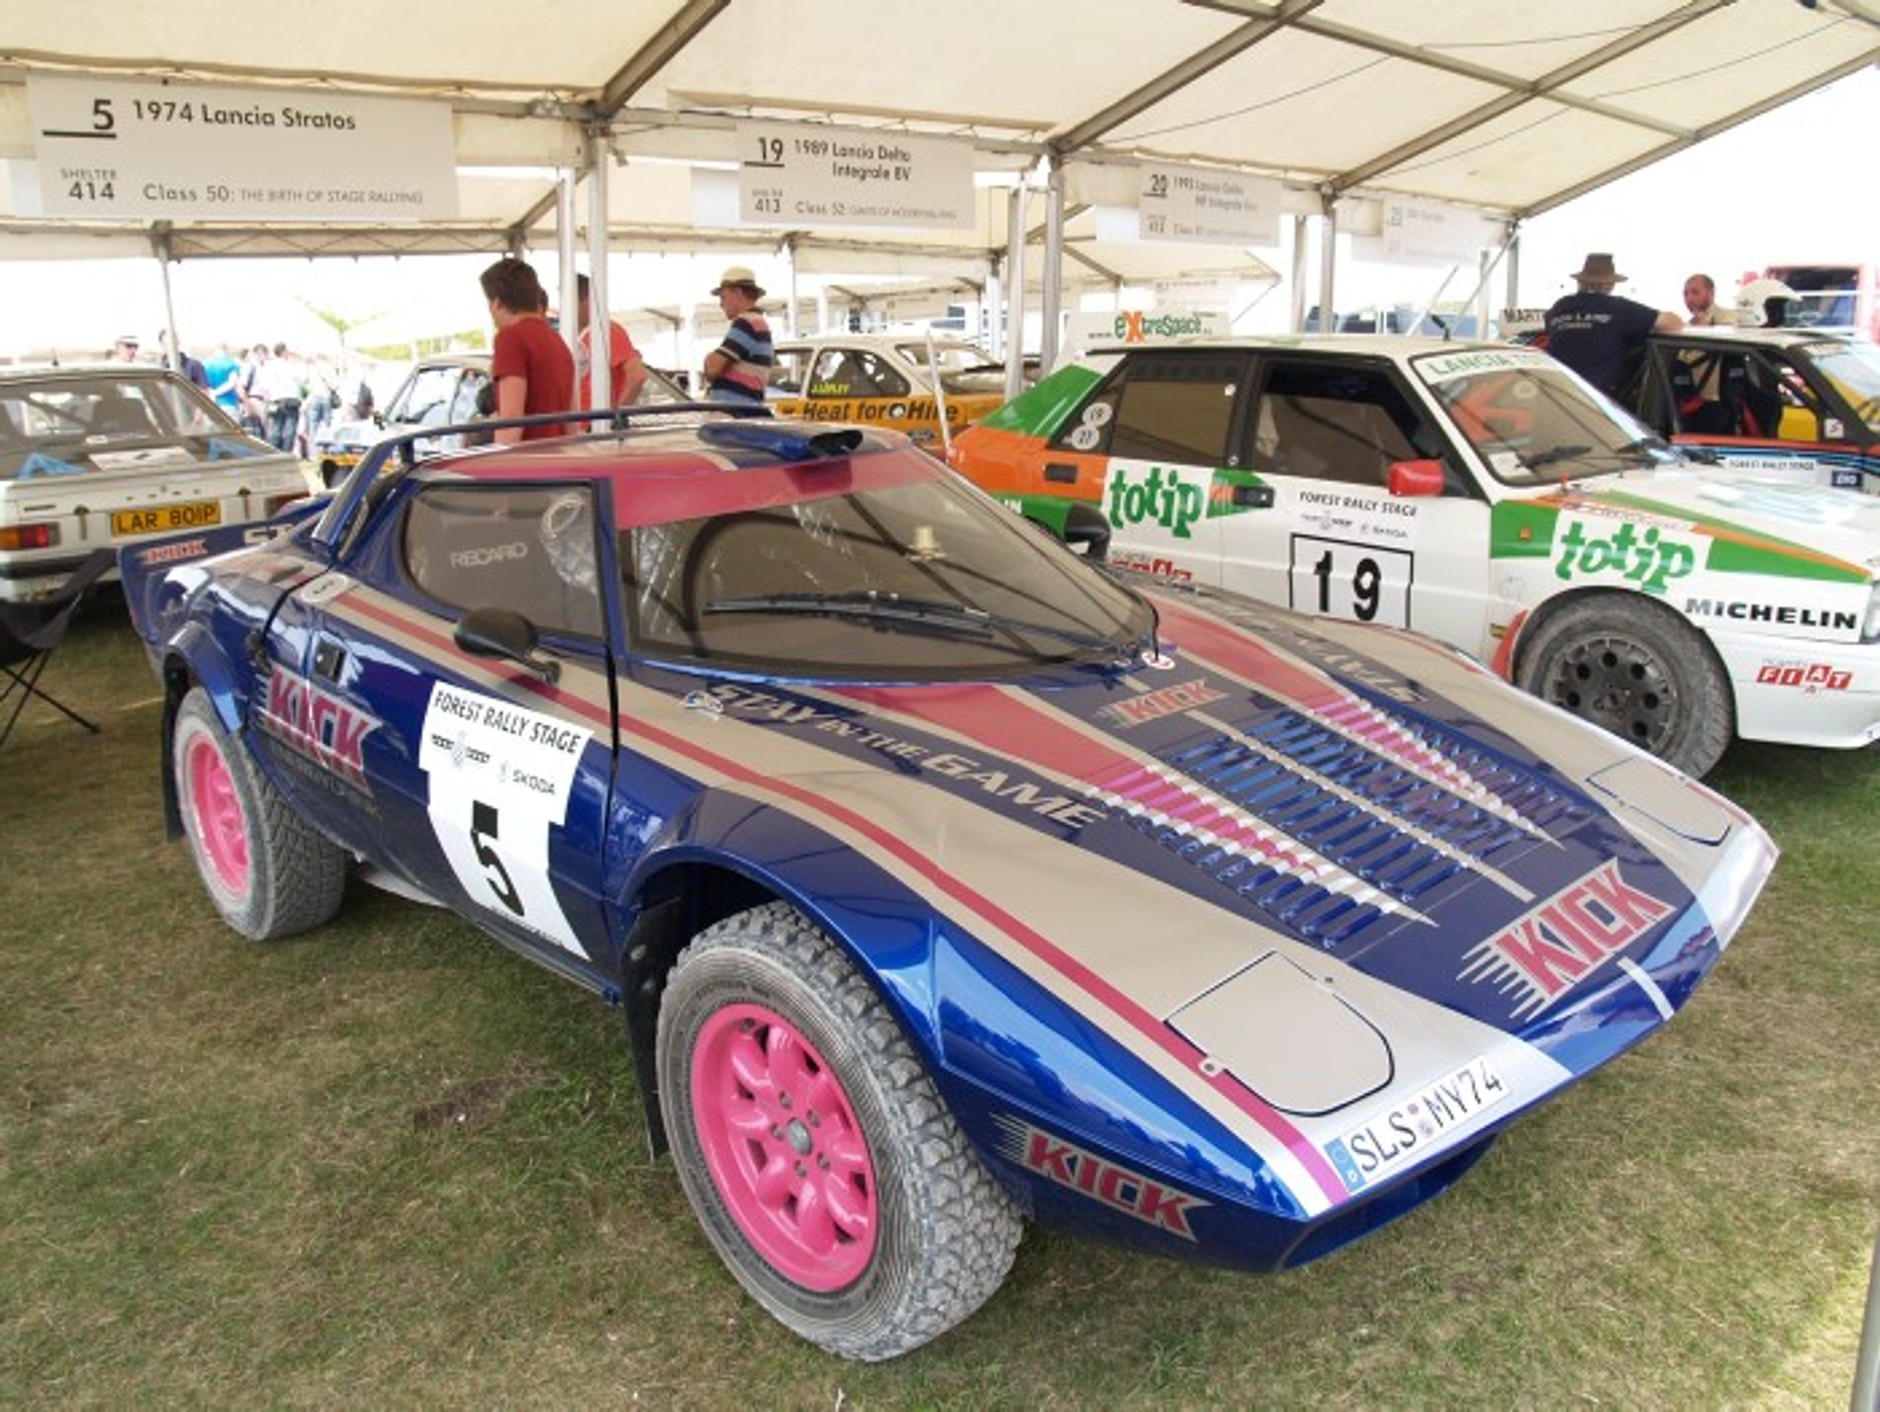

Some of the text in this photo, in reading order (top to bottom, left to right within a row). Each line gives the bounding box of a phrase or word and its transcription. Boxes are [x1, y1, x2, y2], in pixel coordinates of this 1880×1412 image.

[93, 100, 115, 131] 5
[133, 100, 357, 130] 1974 Lancia Stratos
[758, 137, 784, 162] 19
[795, 139, 912, 162] 1989 Lancia Delta
[60, 168, 118, 181] SHELTER
[832, 161, 891, 182] Integrale
[1151, 174, 1168, 193] 20
[68, 182, 115, 200] 414
[143, 182, 198, 202] Class
[240, 189, 265, 203] THE
[306, 190, 323, 203] OF
[327, 190, 366, 204] STAGE
[755, 198, 781, 214] 413
[795, 201, 828, 216] Class
[803, 403, 850, 421] Heat
[856, 401, 887, 420] for
[1109, 467, 1203, 538] totip
[1299, 491, 1418, 516] FOREST RALLY STAGE
[117, 502, 216, 532] LAR 801P
[451, 541, 528, 568] RECARO
[1555, 520, 1694, 594] totip
[1314, 549, 1382, 622] 19
[1684, 598, 1857, 630] MICHELIN
[1756, 663, 1853, 689] FIAT
[1111, 679, 1228, 727] KICK
[433, 689, 582, 754] FOREST RALLY STAGE
[709, 684, 1108, 828] STAY IN THE GAME
[512, 769, 556, 795] SKODA
[469, 799, 525, 917] 5
[1496, 857, 1676, 1000] KICK
[1350, 1060, 1503, 1173] SLS MY74
[1024, 1128, 1213, 1243] KICK
